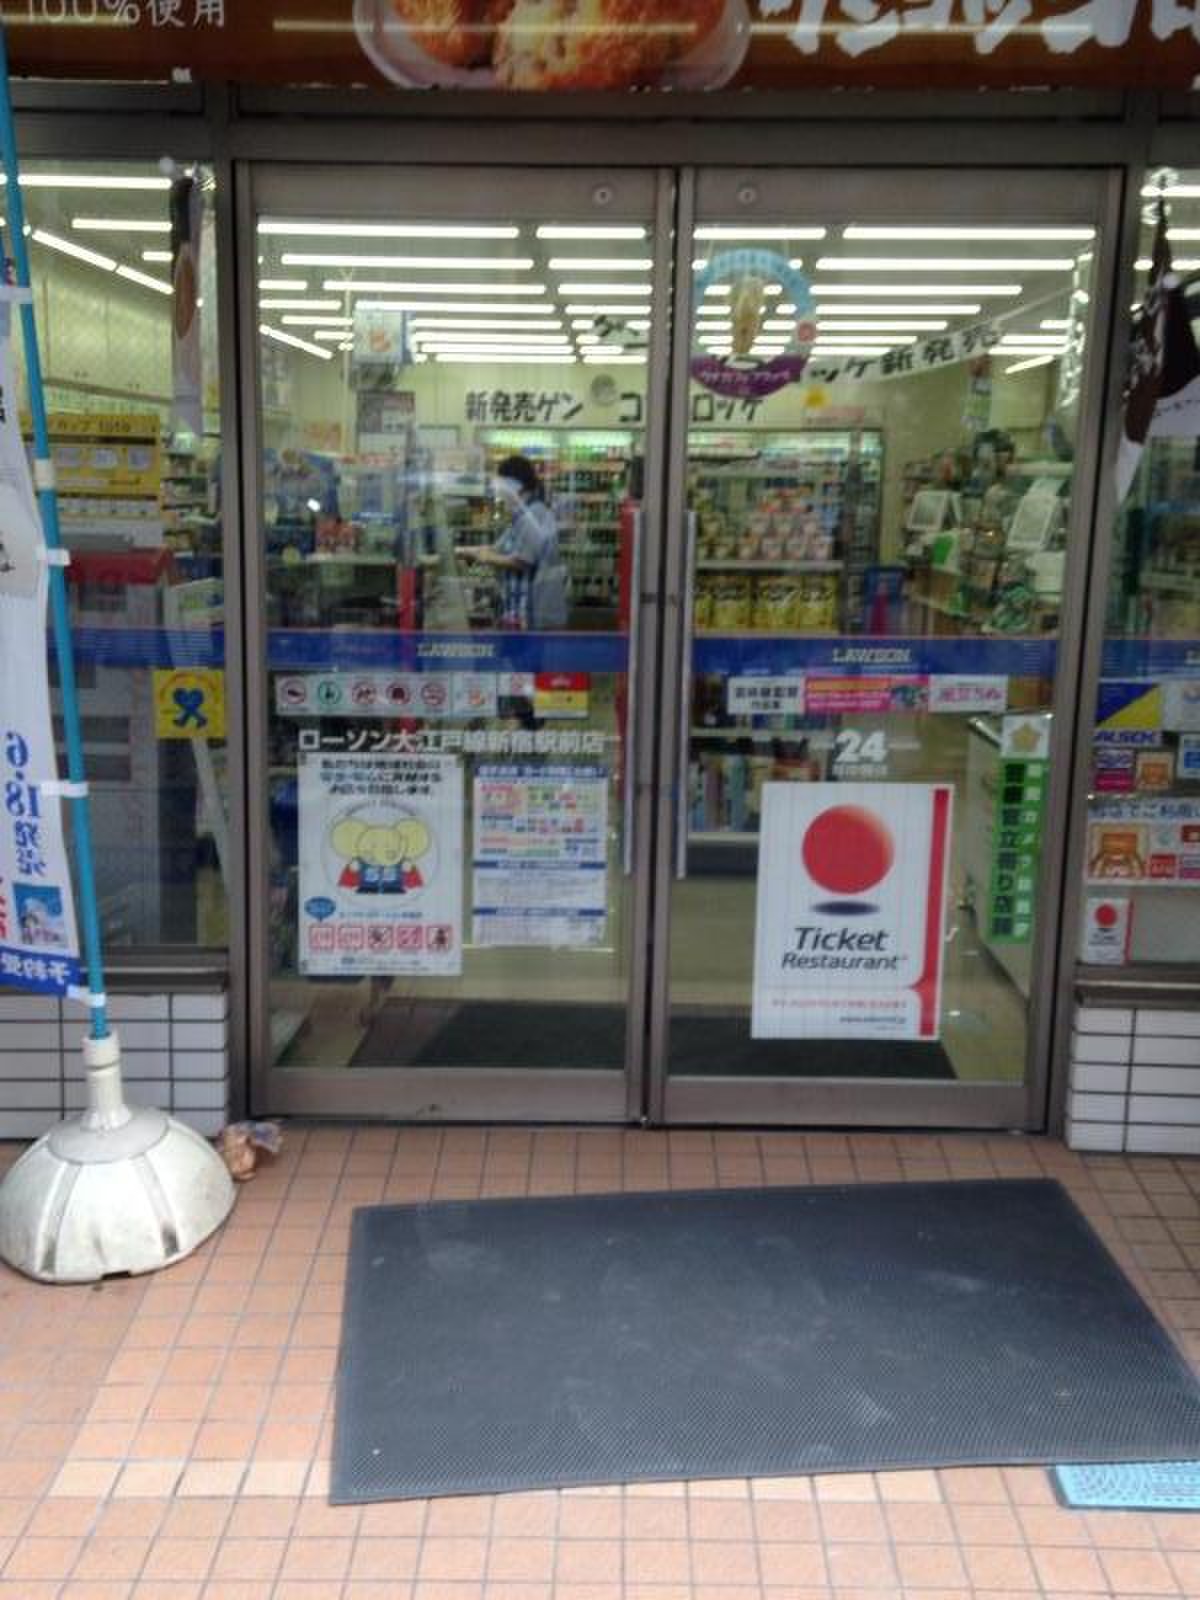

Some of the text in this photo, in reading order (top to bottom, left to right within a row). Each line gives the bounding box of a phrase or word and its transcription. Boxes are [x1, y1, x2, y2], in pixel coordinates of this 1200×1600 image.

[834, 729, 887, 764] 24
[794, 927, 889, 951] Ticket
[781, 952, 899, 970] Restaurant
